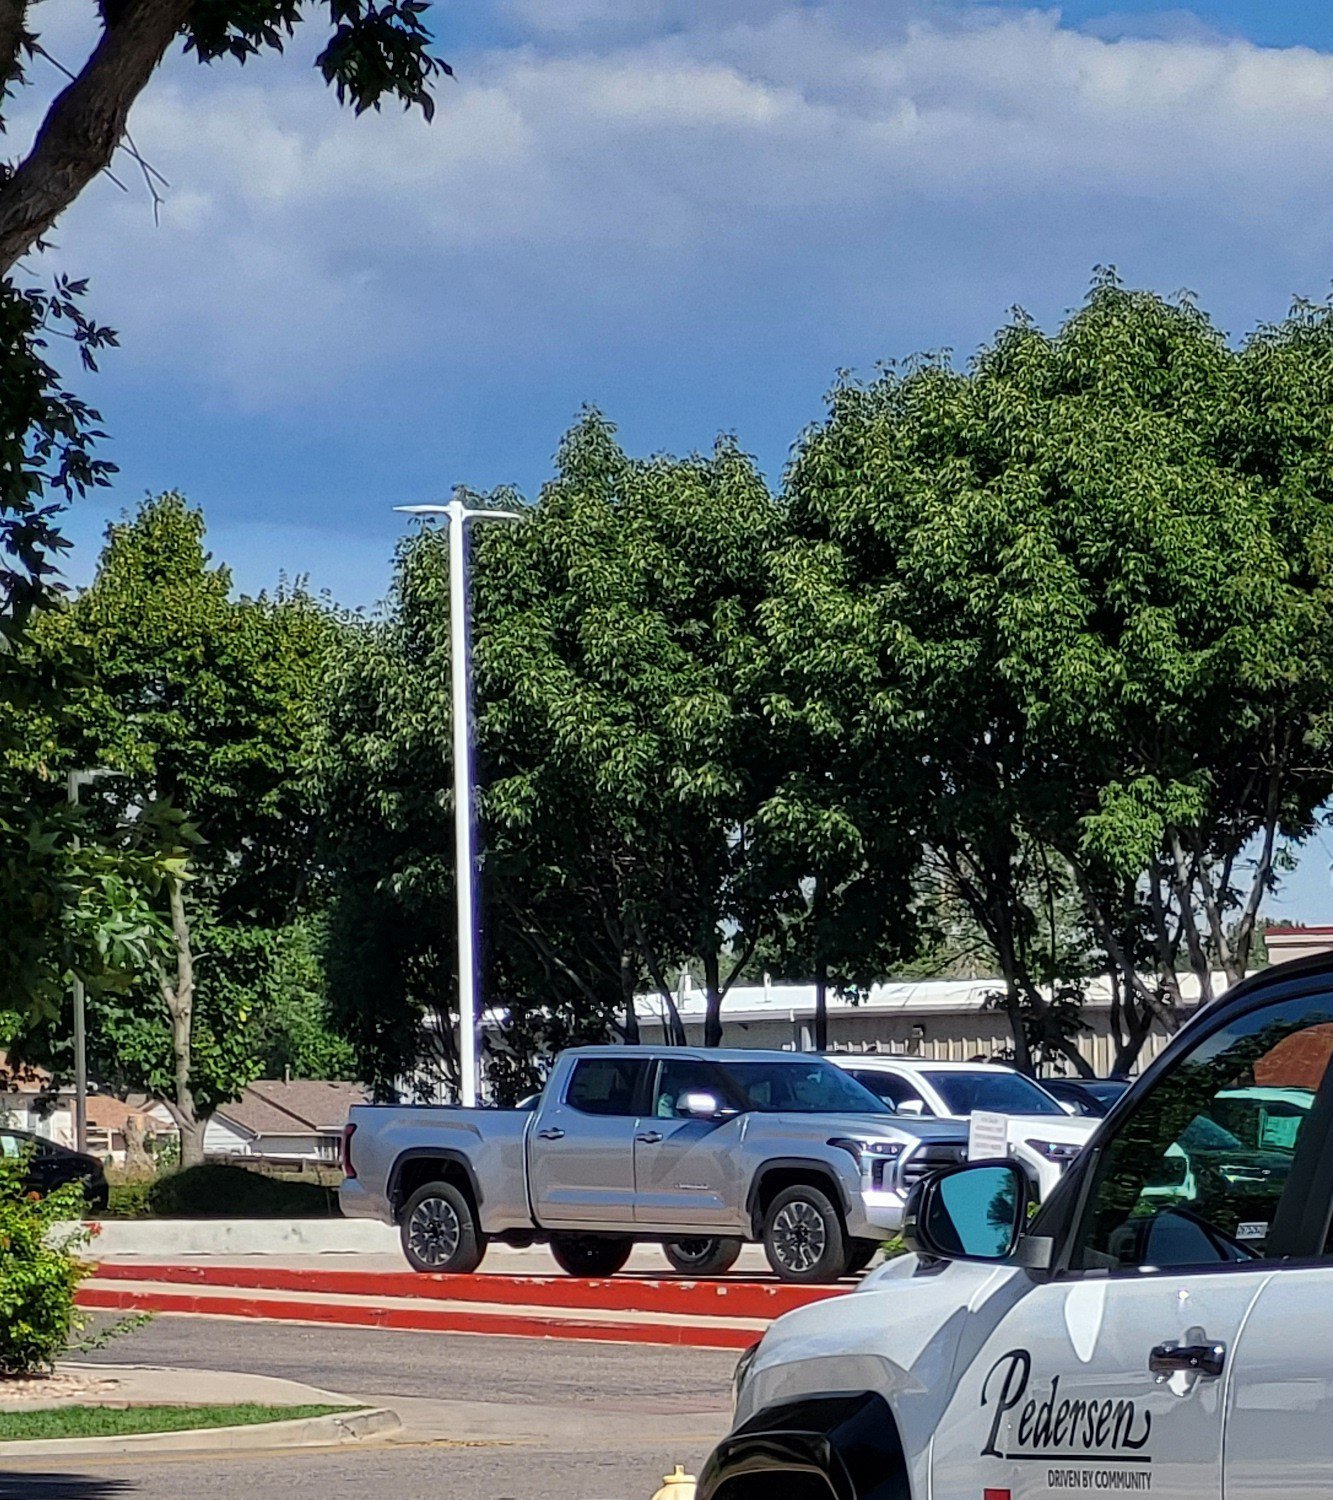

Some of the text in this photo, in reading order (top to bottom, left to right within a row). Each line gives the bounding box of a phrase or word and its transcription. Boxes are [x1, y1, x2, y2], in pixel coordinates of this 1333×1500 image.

[979, 1349, 1152, 1459] Pedersen
[1047, 1470, 1152, 1490] DRIVEN BY COMMUNITY
